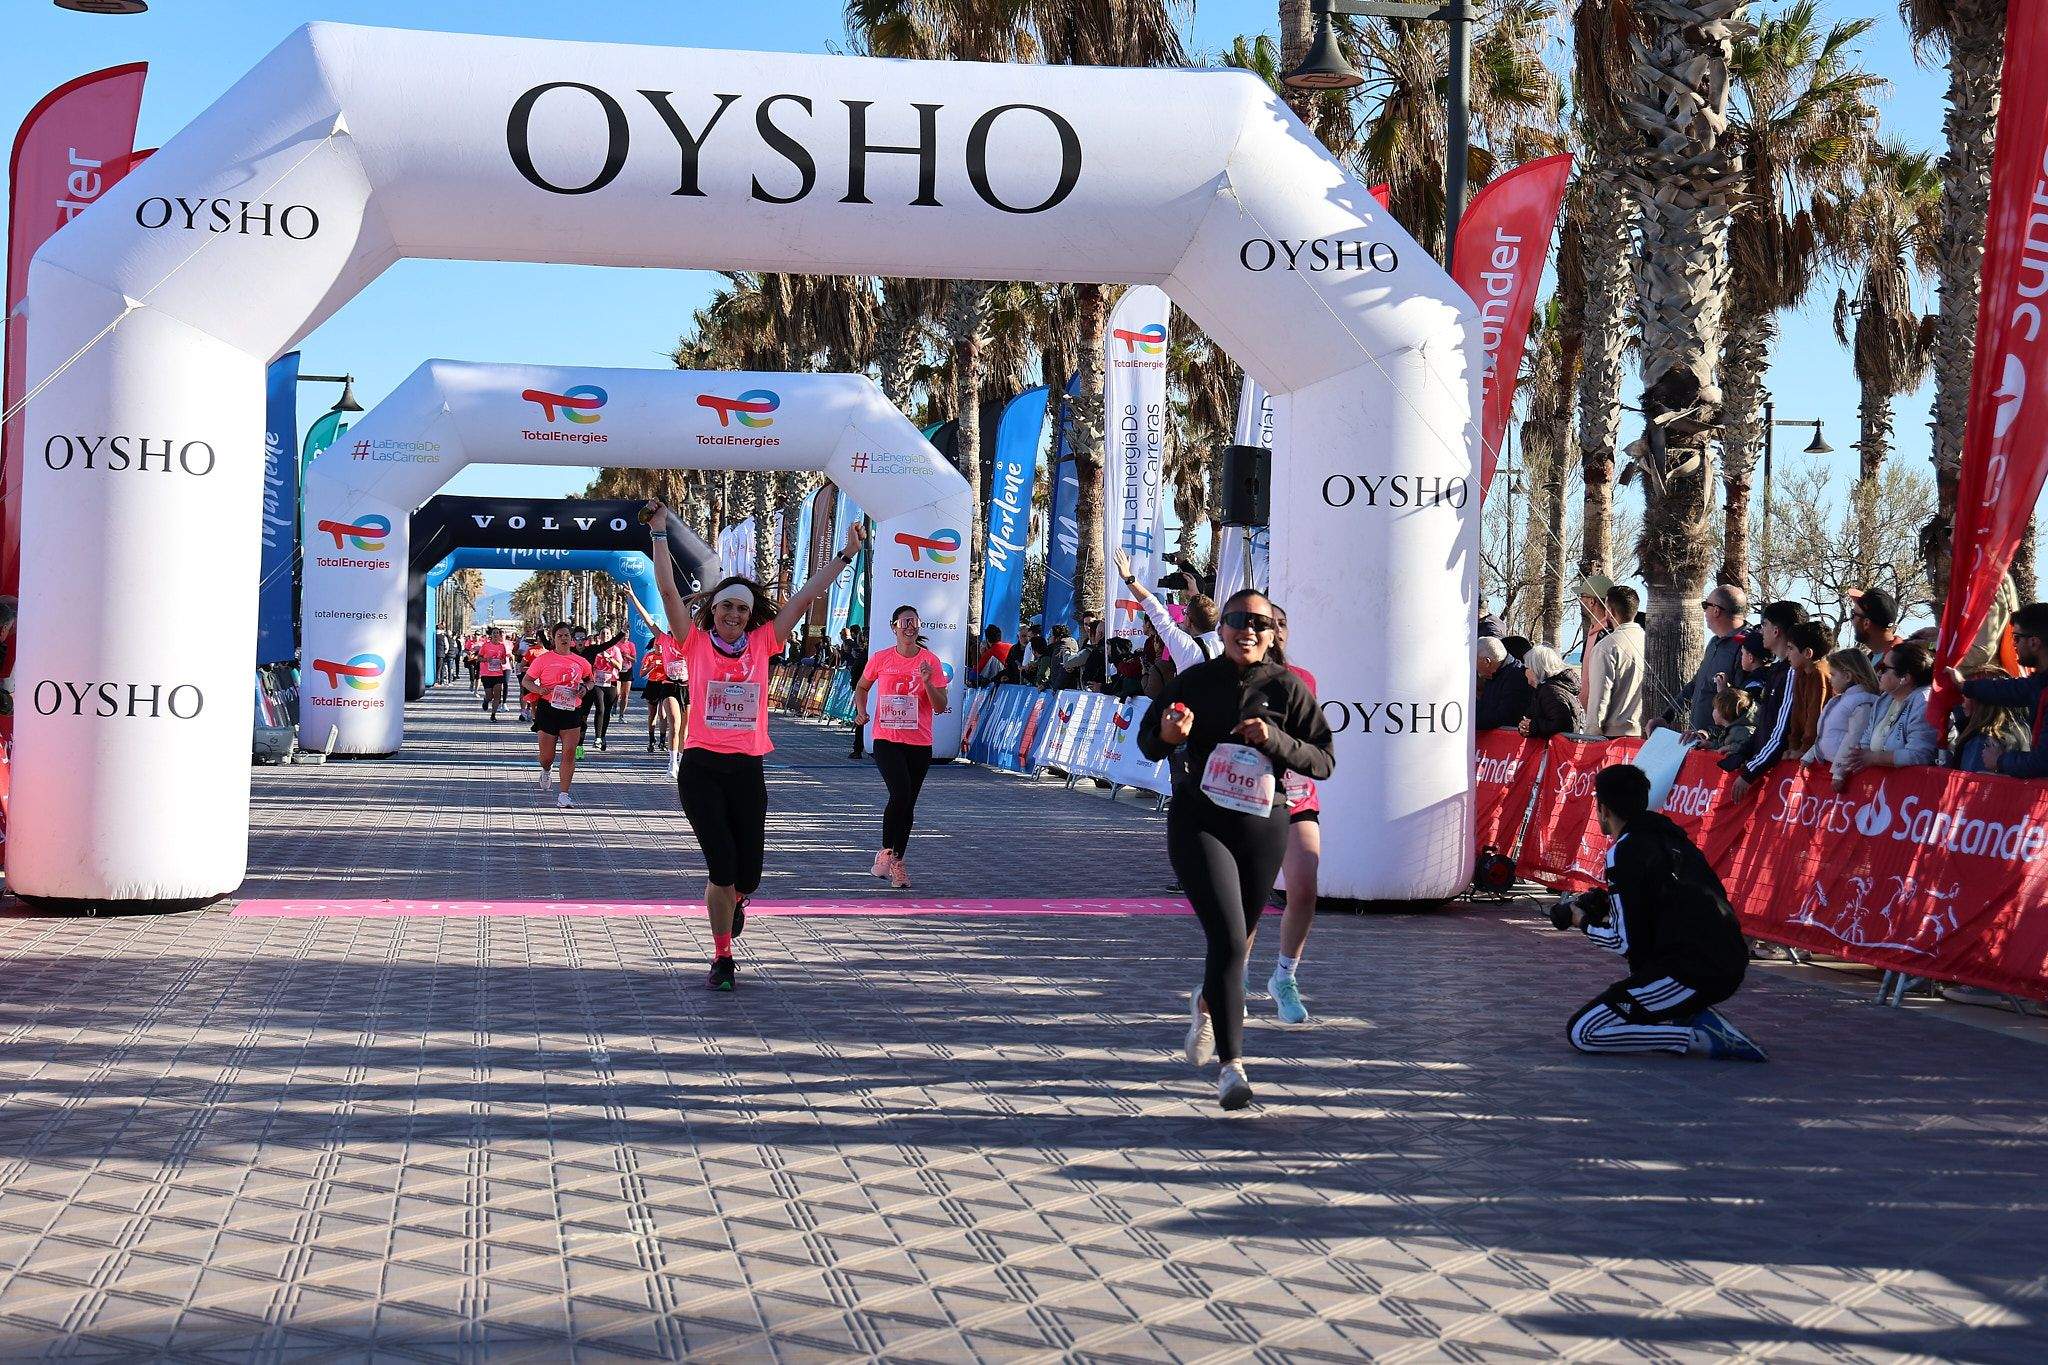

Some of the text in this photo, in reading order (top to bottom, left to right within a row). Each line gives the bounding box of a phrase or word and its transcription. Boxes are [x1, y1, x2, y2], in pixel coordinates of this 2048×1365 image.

[506, 81, 1082, 214] OYSHO
[135, 196, 320, 240] OYSHO
[1240, 238, 1399, 273] OYSHO
[1479, 226, 1523, 398] ander
[1113, 359, 1165, 370] TotalEnergie
[521, 430, 608, 444] TotalEnergies
[696, 434, 780, 448] TotalEnergies
[45, 434, 215, 476] OYSHO
[1322, 474, 1468, 509] OYSHO
[471, 514, 628, 531] VOLVO
[987, 461, 1027, 572] Marlene
[316, 557, 390, 570] TotalEnergies
[892, 568, 960, 582] TotalEnergies
[314, 610, 388, 620] totalenergies.es
[919, 621, 957, 630] ergies.es
[34, 679, 204, 719] OYSHO
[311, 696, 385, 709] TotalEnergies
[724, 702, 744, 712] 016
[892, 709, 907, 717] 016
[1320, 700, 1463, 735] OYSHO
[1228, 772, 1256, 788] 016
[1771, 777, 2046, 863] Sports Santande
